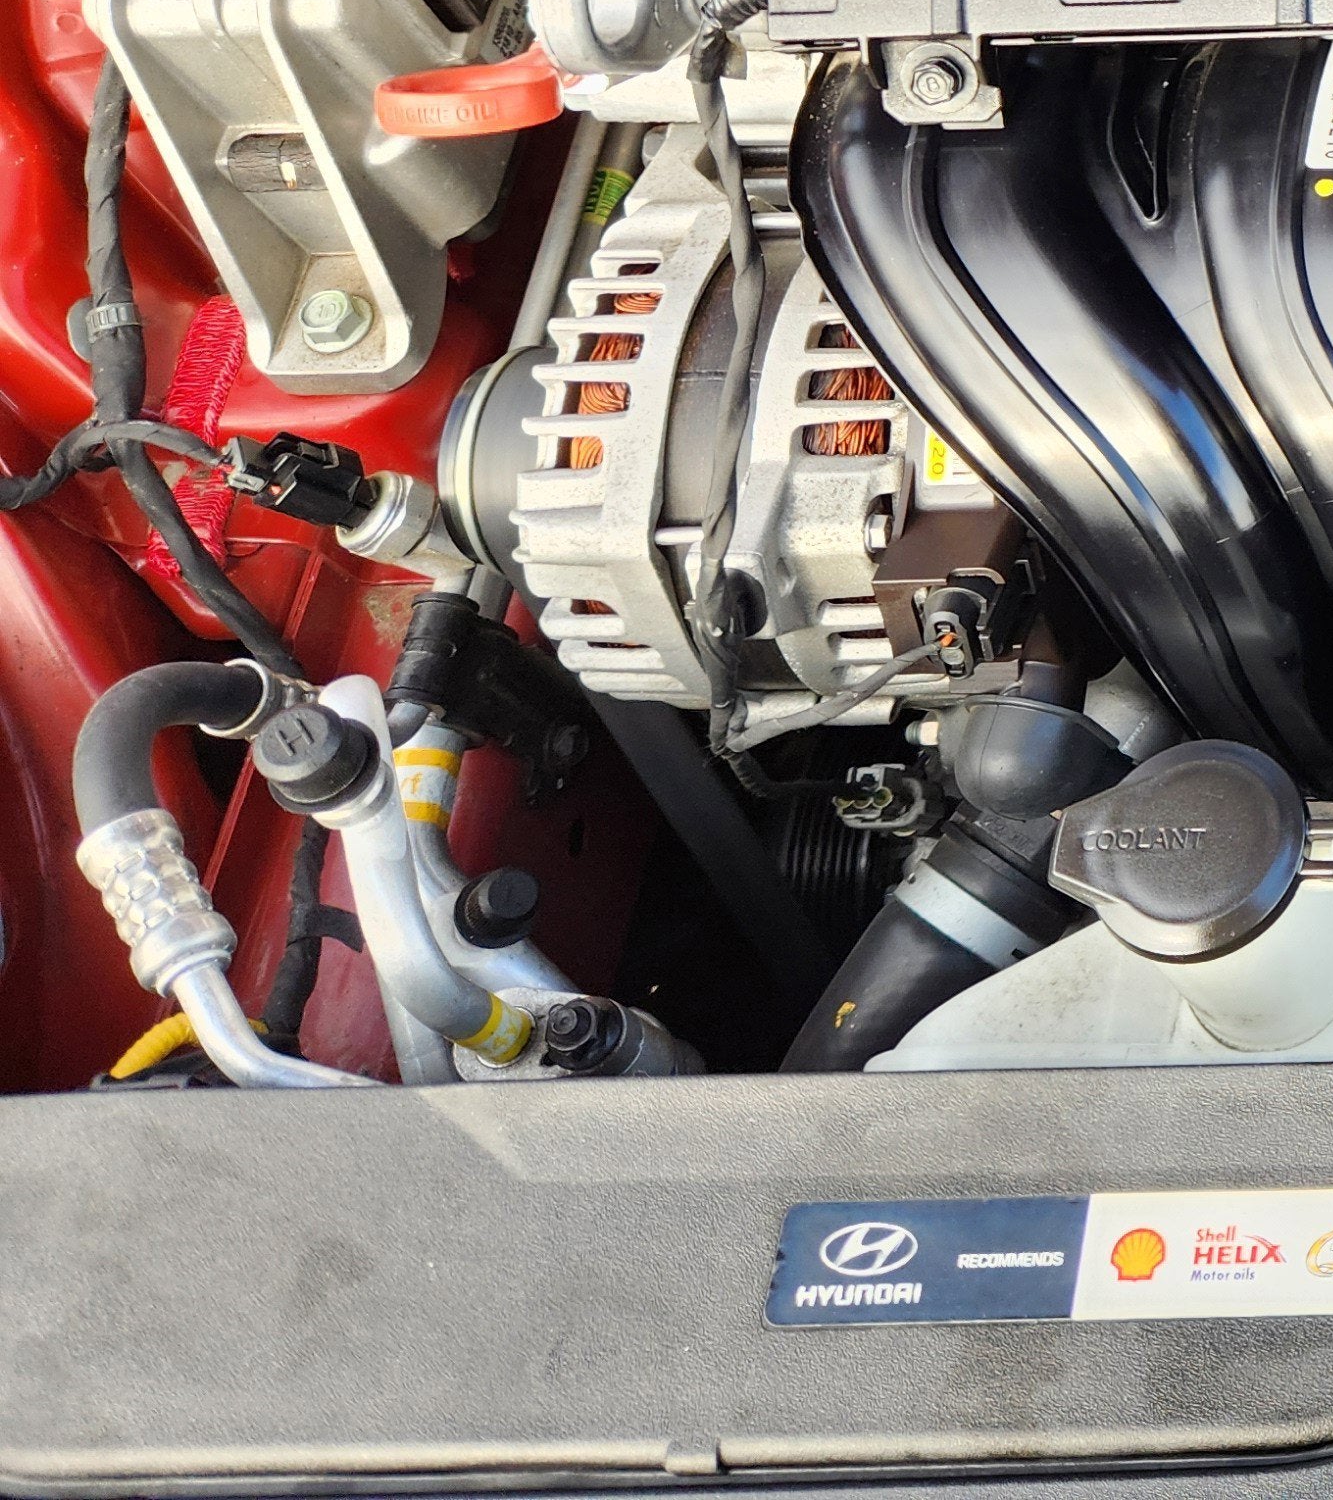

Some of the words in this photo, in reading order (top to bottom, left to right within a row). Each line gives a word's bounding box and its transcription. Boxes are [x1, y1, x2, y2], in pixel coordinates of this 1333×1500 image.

[388, 106, 449, 125] ENGINE
[456, 100, 493, 123] OIL
[1082, 826, 1207, 851] COOLANT
[1196, 1225, 1238, 1243] Shell
[956, 1251, 1065, 1270] RECOMMENDS
[1193, 1242, 1285, 1265] HELIX
[1190, 1269, 1229, 1282] Motor
[1233, 1267, 1255, 1281] oils
[795, 1282, 924, 1308] HYUNDAI
